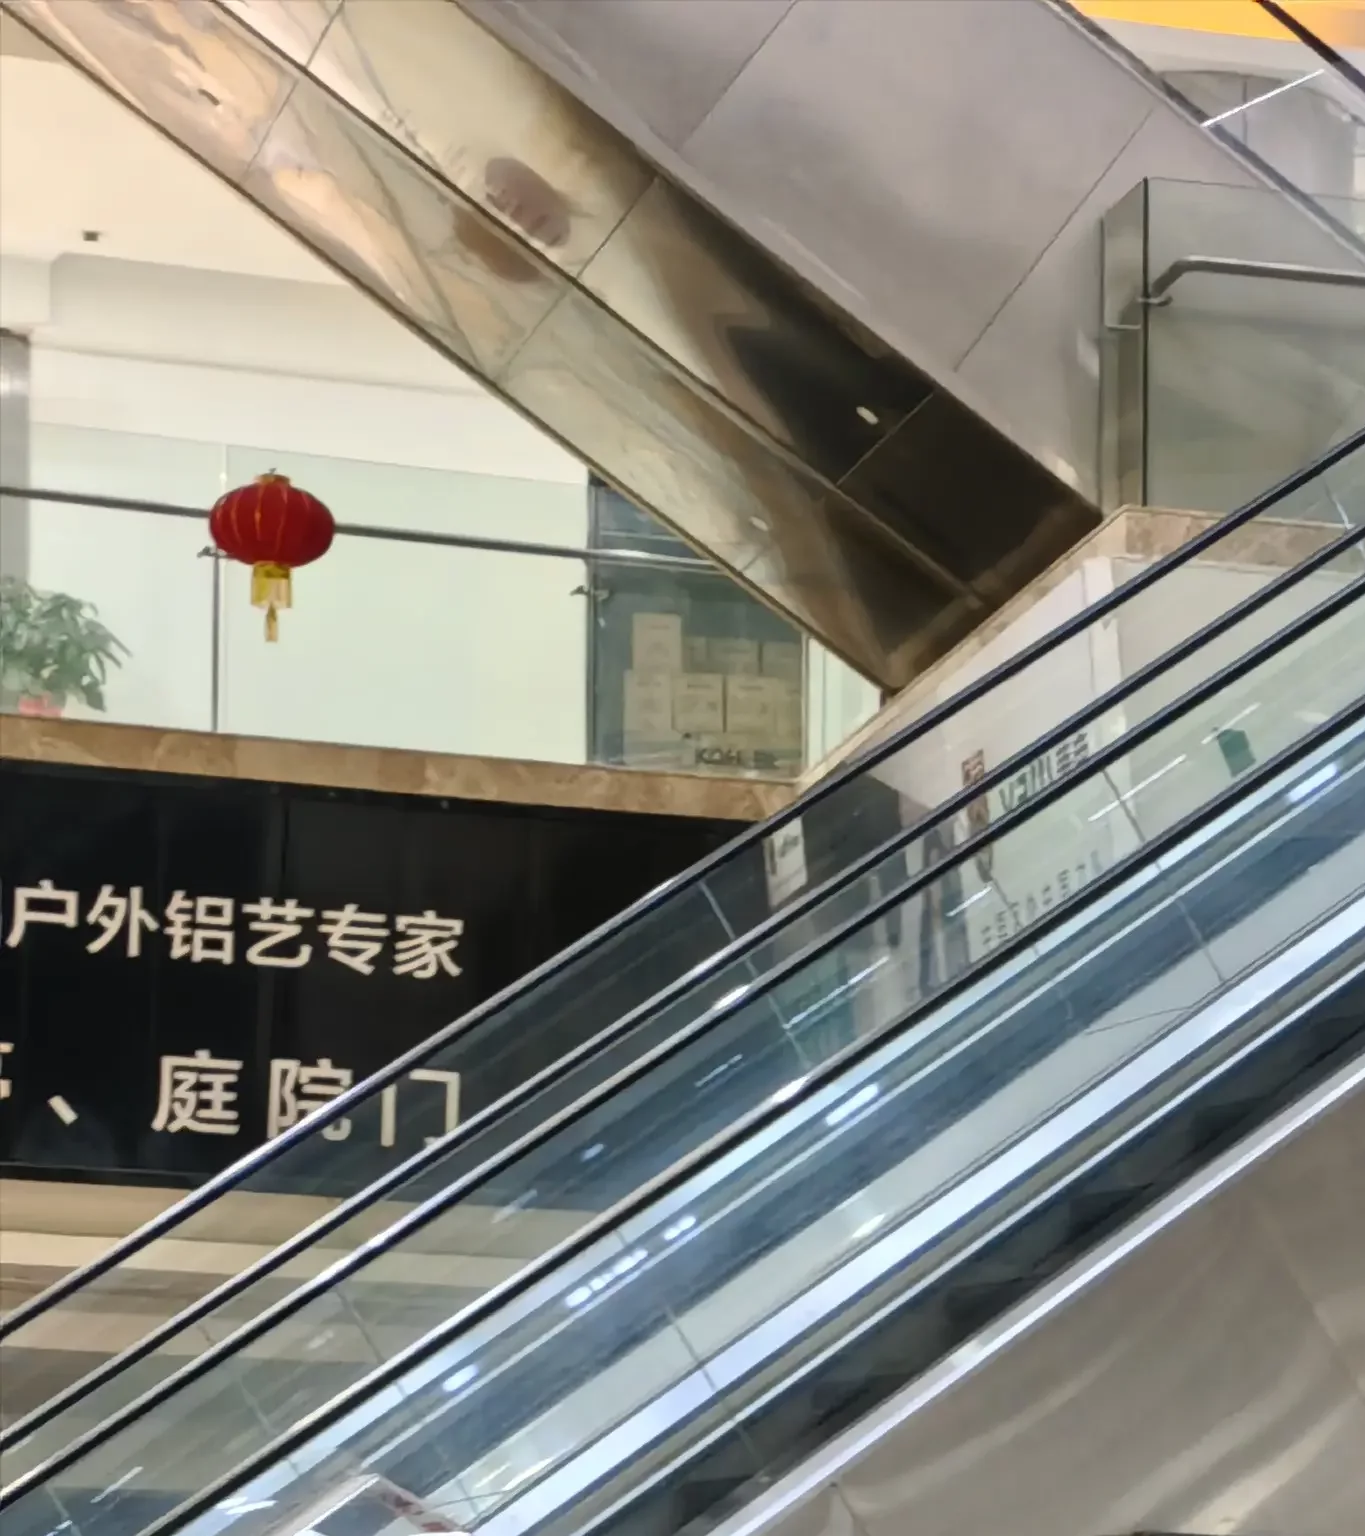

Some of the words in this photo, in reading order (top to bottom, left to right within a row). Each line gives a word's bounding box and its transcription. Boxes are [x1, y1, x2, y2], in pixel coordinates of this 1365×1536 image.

[5, 878, 465, 980] 户外铝艺专家
